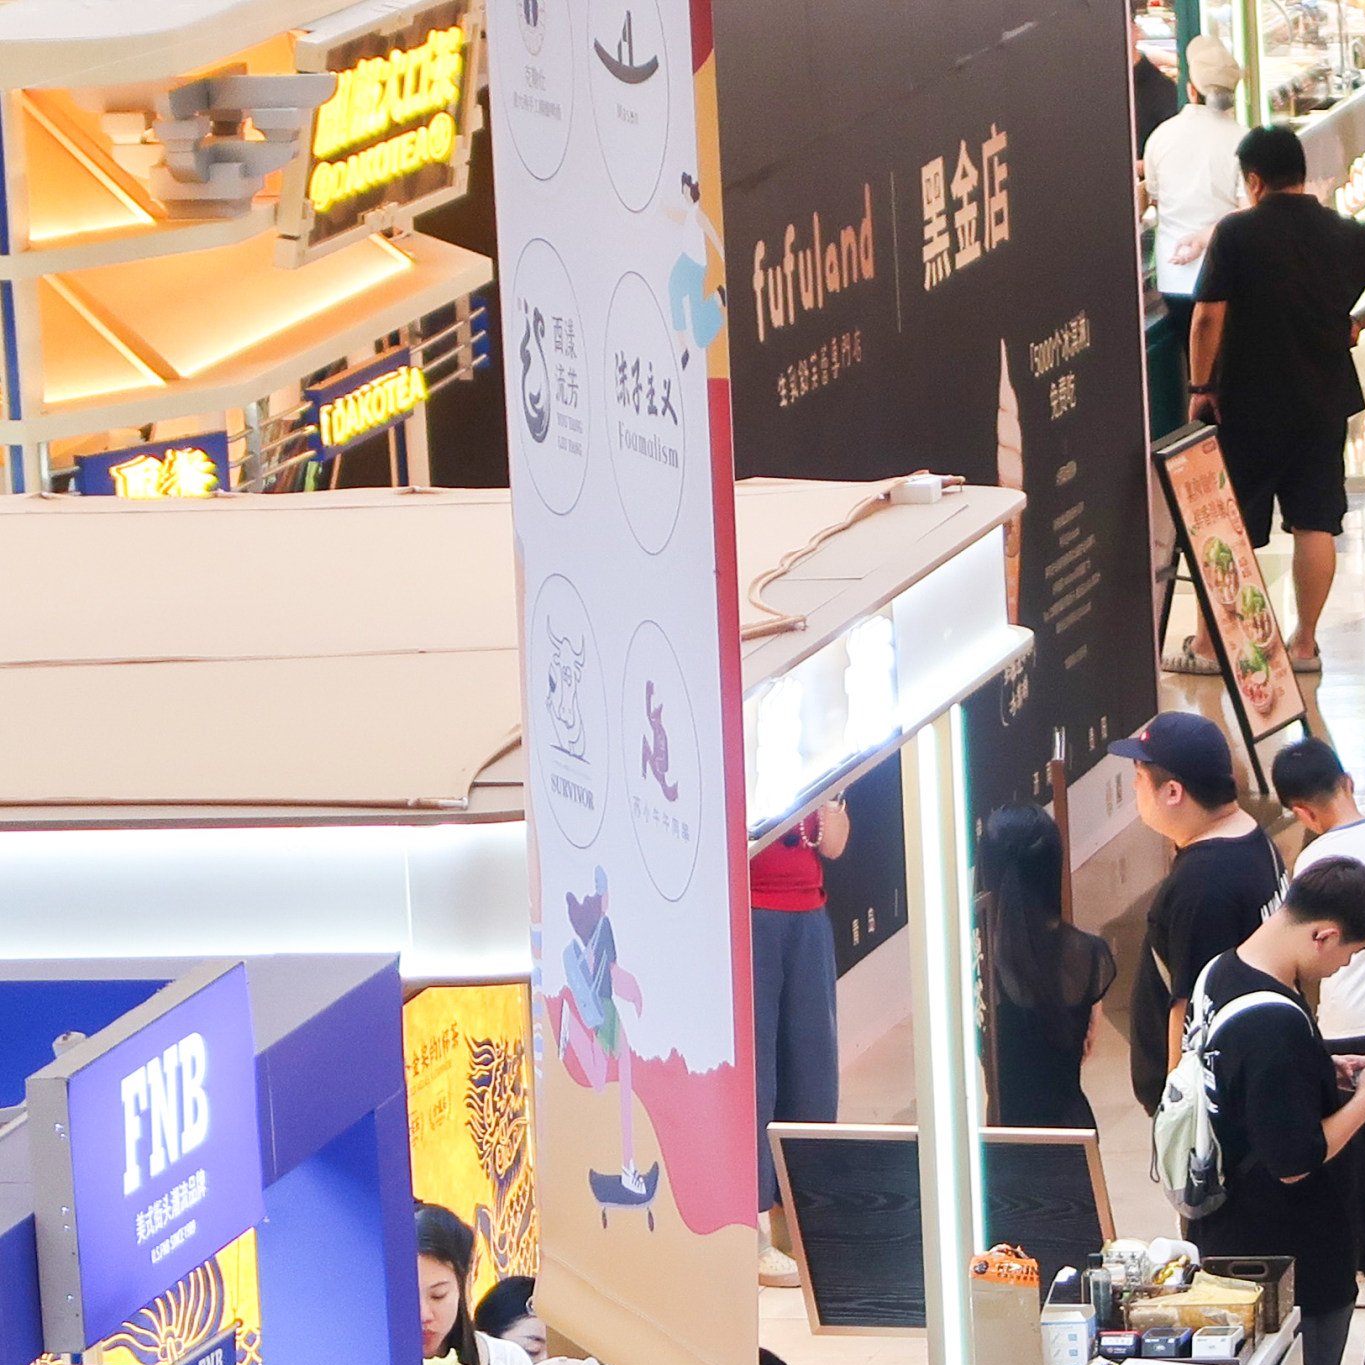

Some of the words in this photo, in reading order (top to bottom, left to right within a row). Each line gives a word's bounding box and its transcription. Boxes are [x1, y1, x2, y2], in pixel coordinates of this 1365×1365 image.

[753, 182, 875, 343] fufuland
[921, 122, 1010, 292] 黑金店
[618, 421, 679, 469] Foamalism
[551, 773, 594, 810] SURVIVOR
[121, 1032, 208, 1197] FNB
